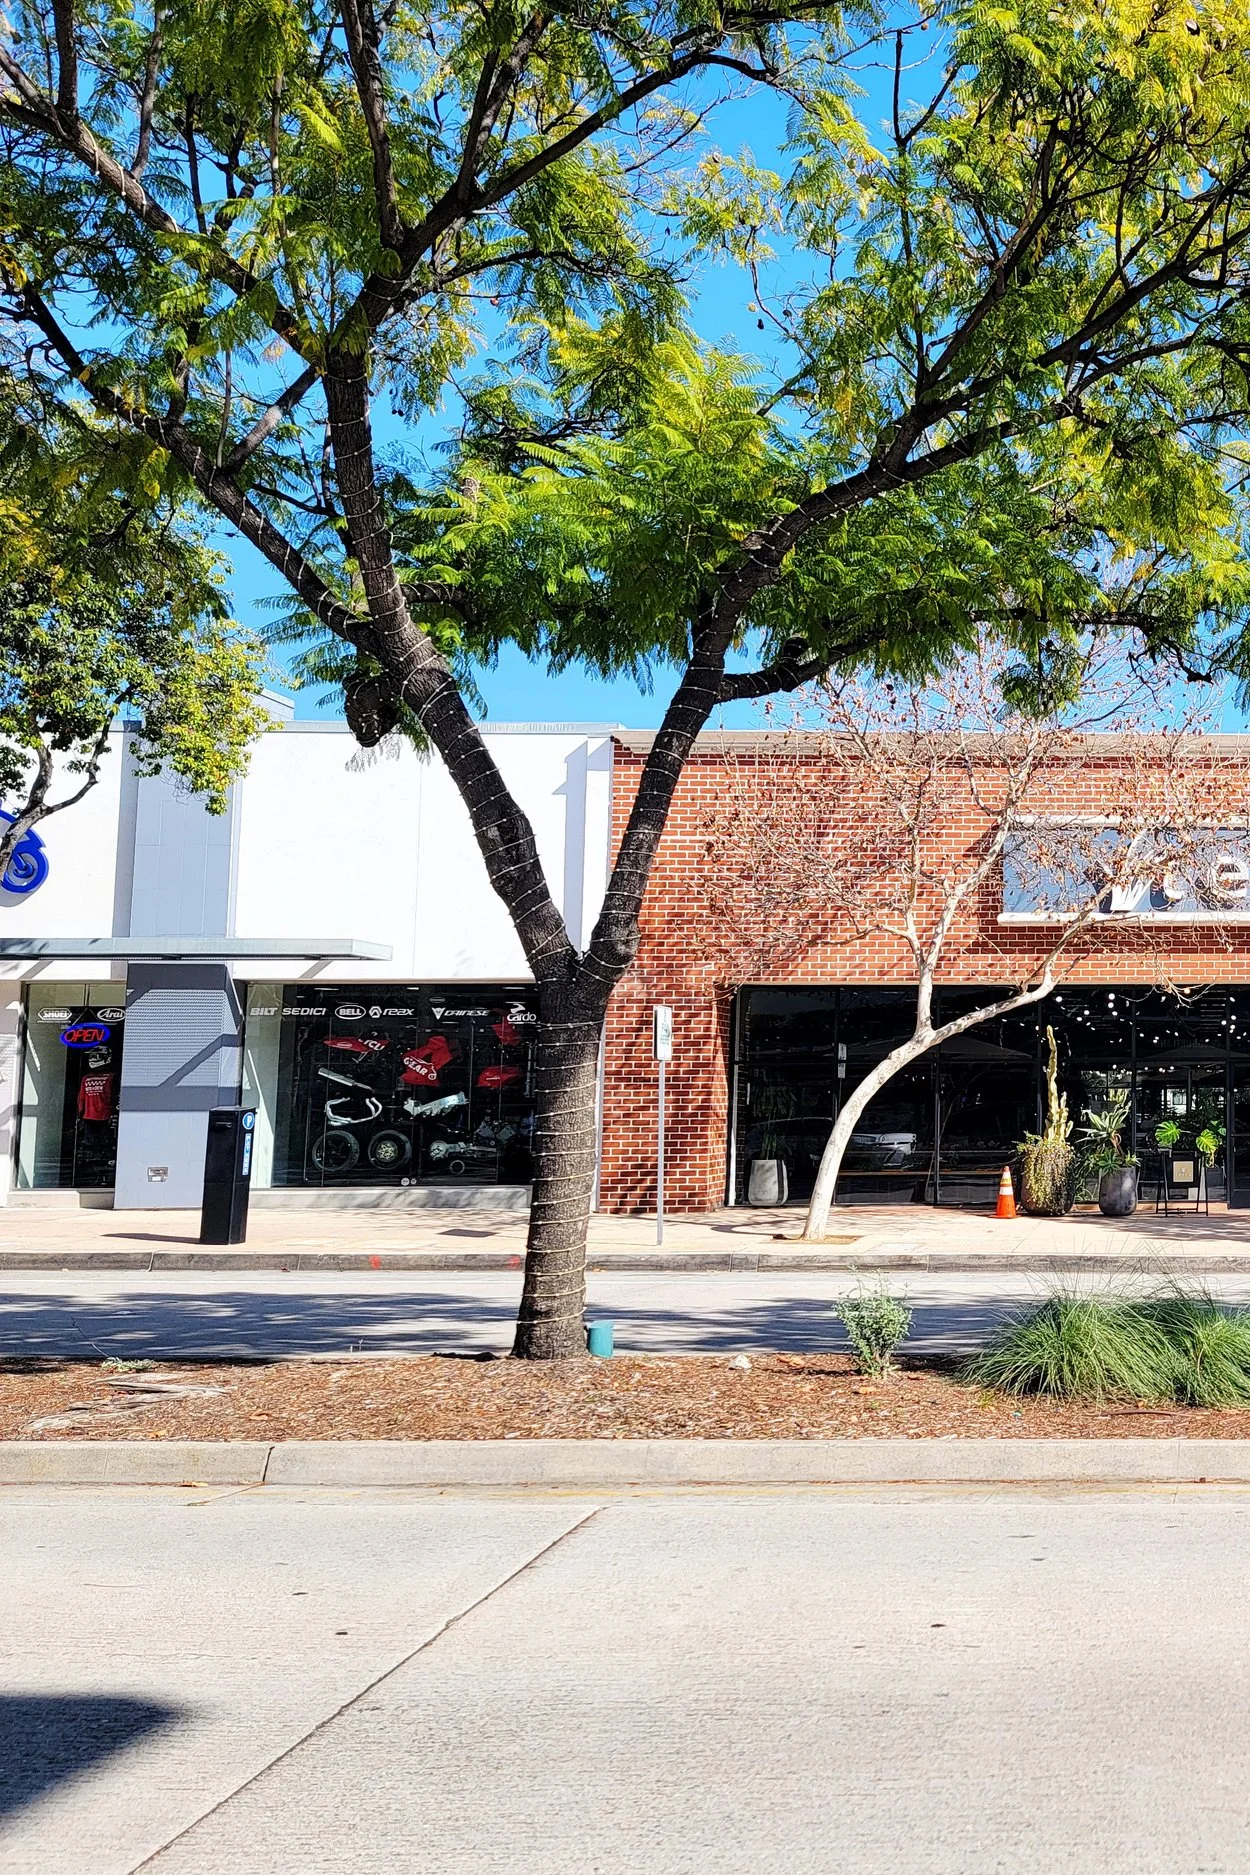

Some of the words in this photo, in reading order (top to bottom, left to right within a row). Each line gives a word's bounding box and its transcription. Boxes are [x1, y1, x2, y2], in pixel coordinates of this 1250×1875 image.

[42, 1010, 68, 1018] SHOEI
[99, 1009, 123, 1018] Arai
[250, 1007, 278, 1016] BILT
[282, 1007, 327, 1015] SEDICI
[340, 1008, 361, 1016] BELL
[506, 1011, 537, 1022] cardo
[64, 1029, 105, 1042] OPEN
[403, 1056, 429, 1076] GEAR
